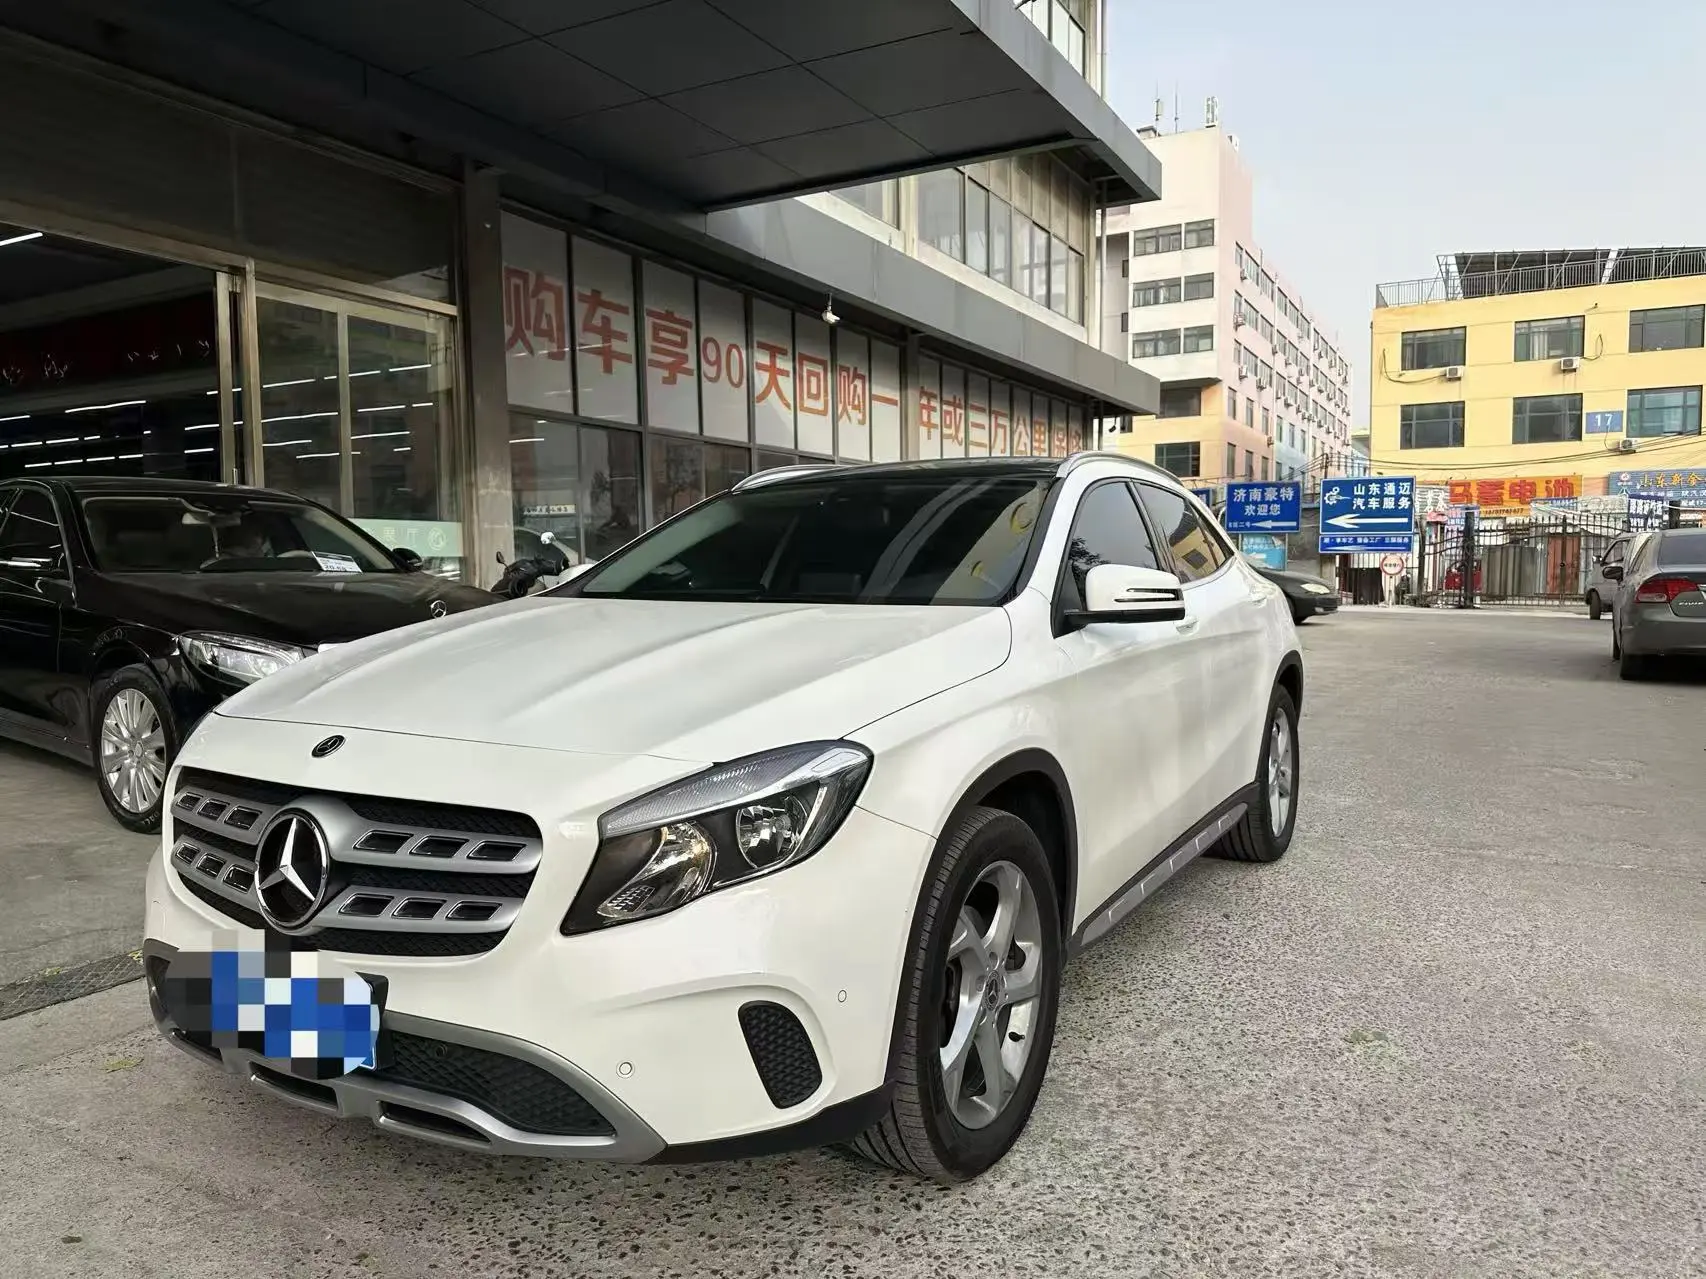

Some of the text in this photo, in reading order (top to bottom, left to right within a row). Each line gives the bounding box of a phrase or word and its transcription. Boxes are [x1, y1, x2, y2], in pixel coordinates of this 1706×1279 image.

[1595, 413, 1613, 426] 17
[1233, 486, 1295, 502] 济南豪特
[1353, 482, 1411, 496] 山东通迈
[1244, 503, 1281, 516] 欢迎您
[1352, 496, 1411, 510] 汽车服务
